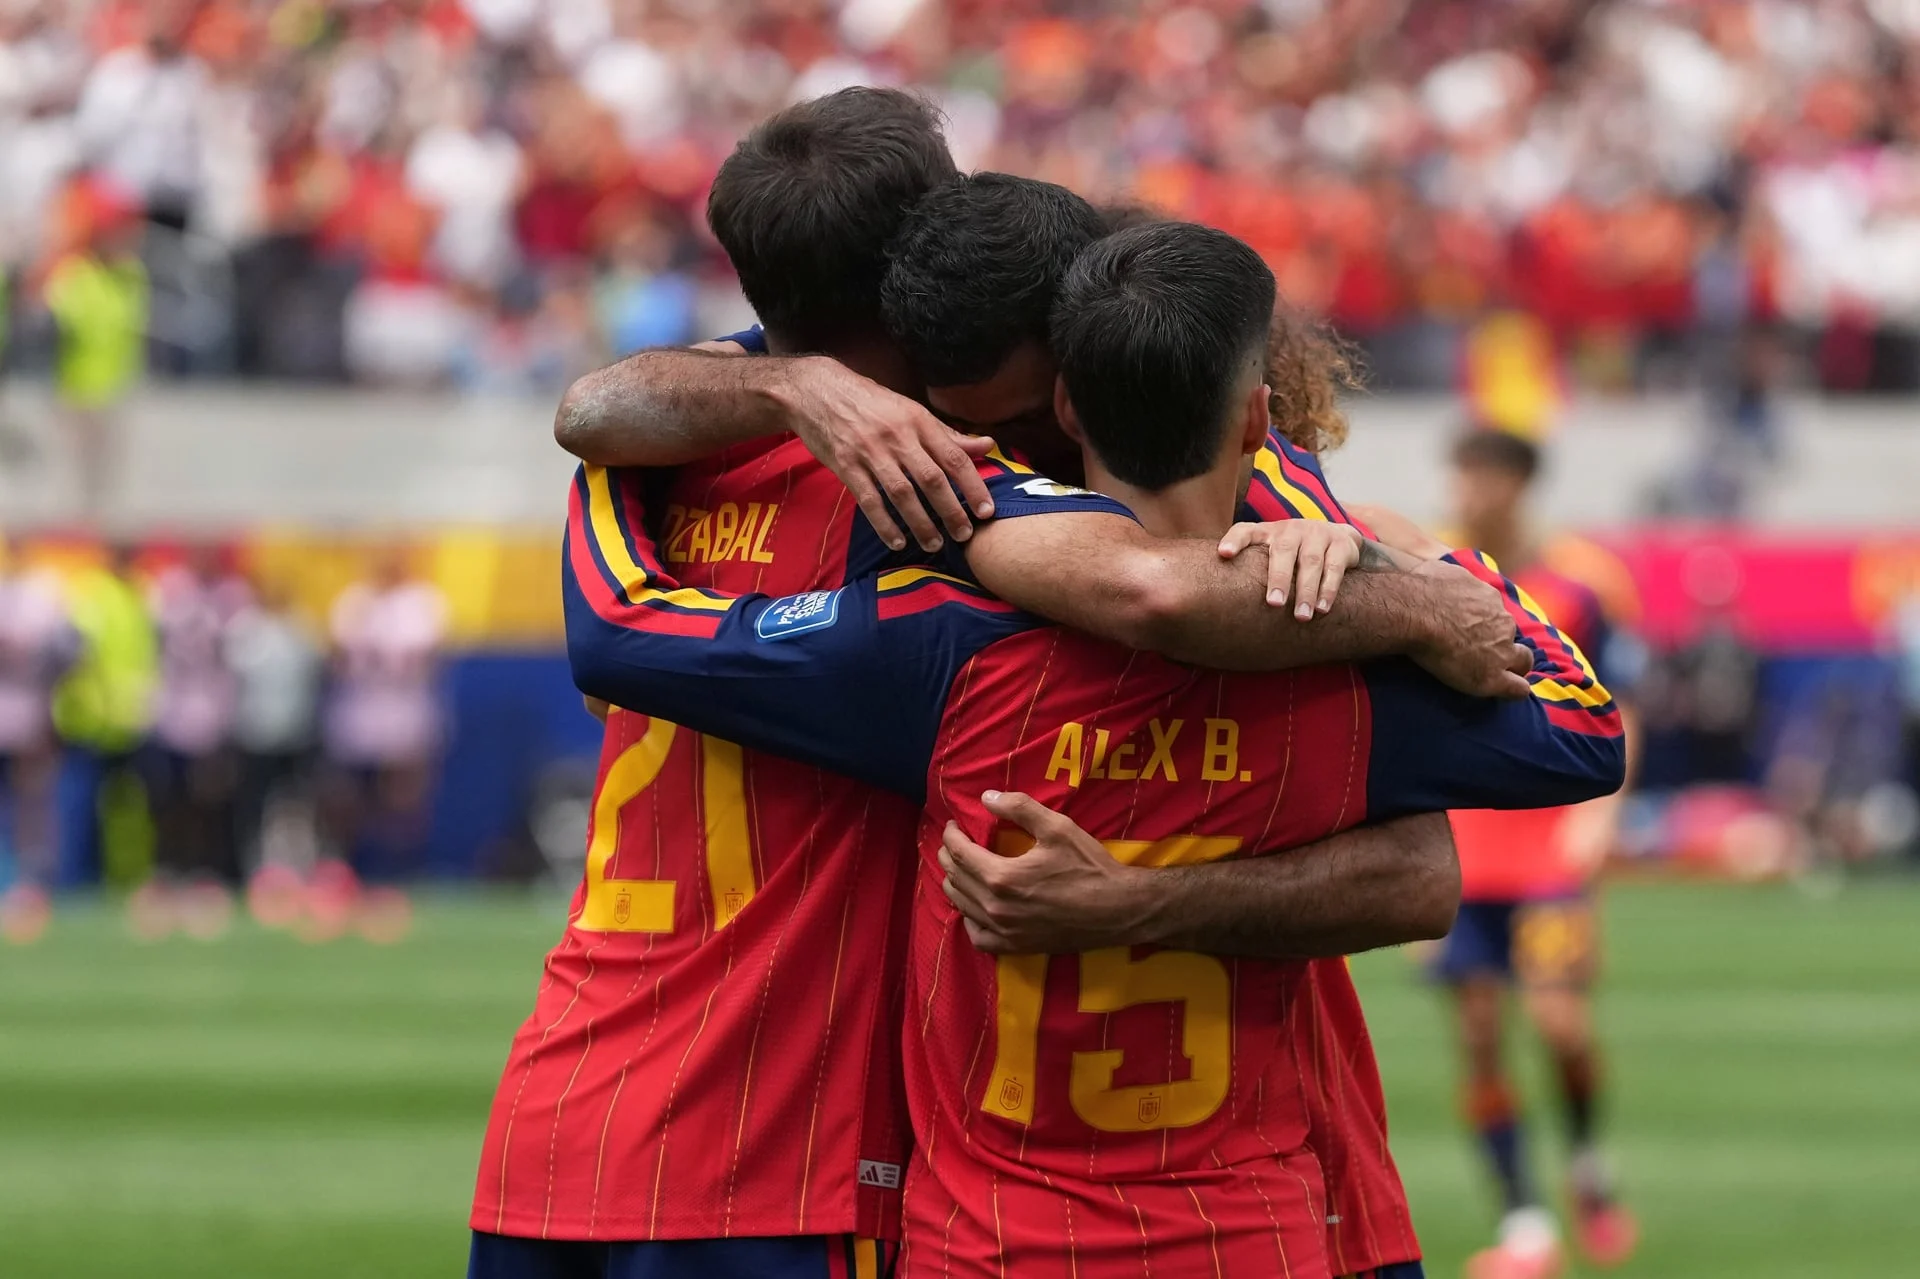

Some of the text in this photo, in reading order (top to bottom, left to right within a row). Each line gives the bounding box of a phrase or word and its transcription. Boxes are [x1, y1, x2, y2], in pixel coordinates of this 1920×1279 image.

[572, 703, 756, 933] 21
[1044, 718, 1252, 787] ALEX B.
[980, 830, 1245, 1132] 15
